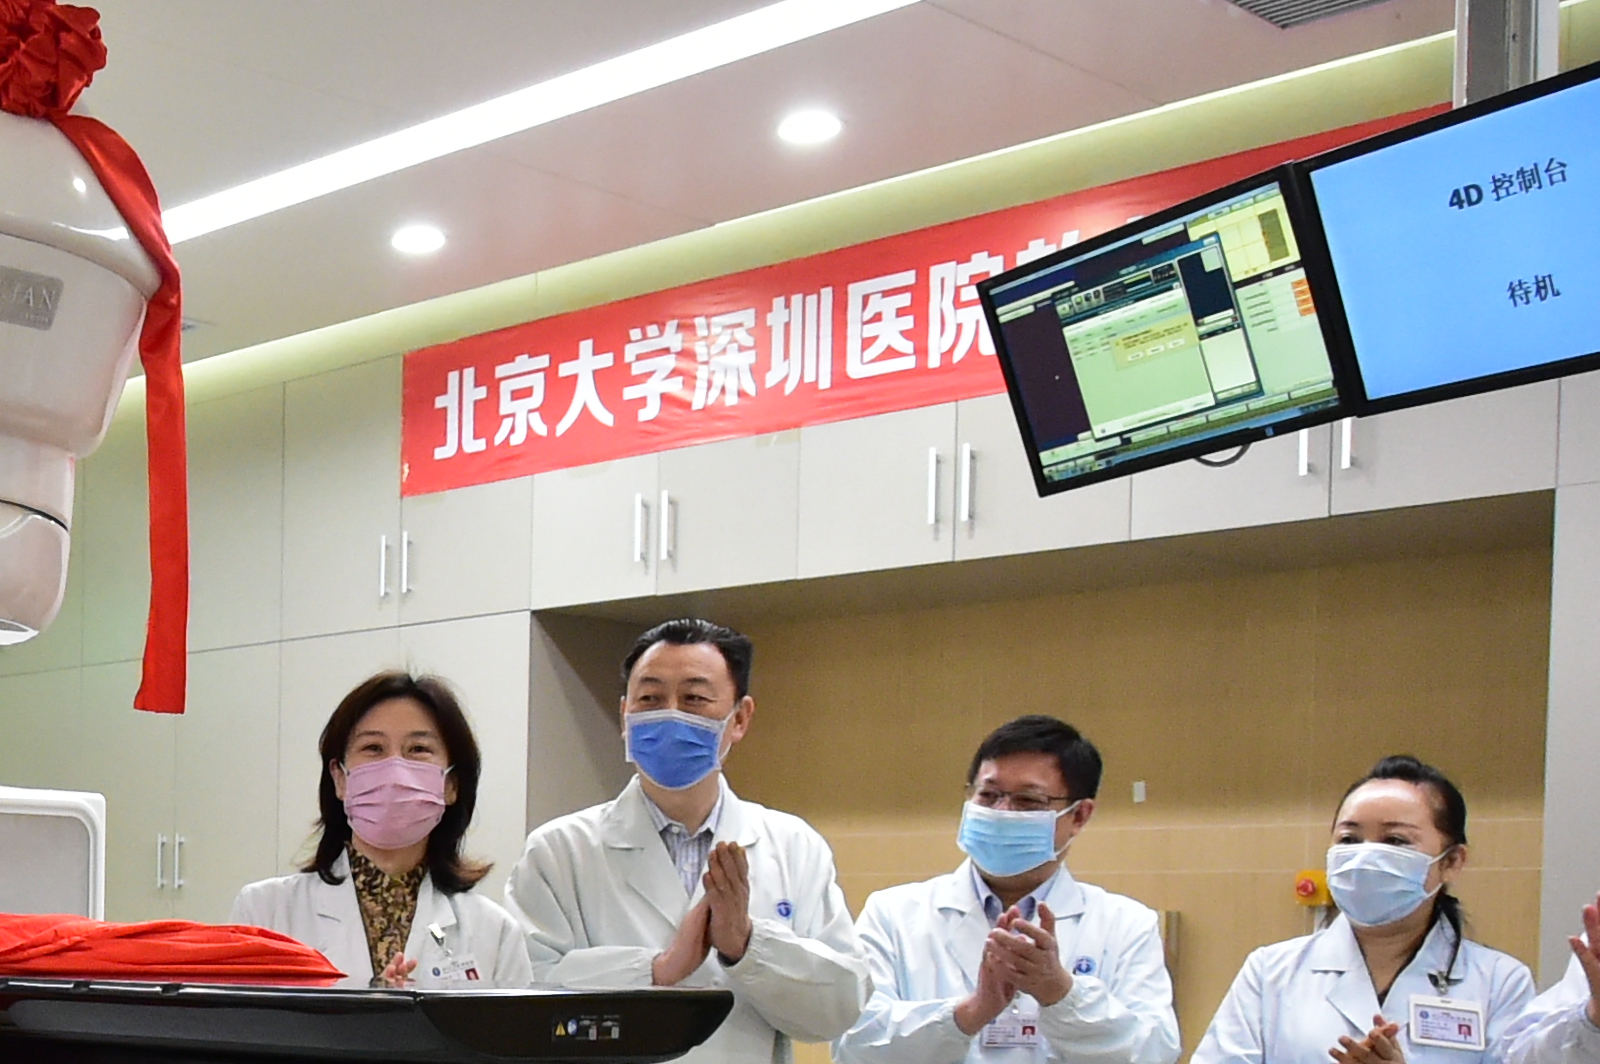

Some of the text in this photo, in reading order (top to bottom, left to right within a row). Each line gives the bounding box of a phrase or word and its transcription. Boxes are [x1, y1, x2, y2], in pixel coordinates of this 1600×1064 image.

[1449, 157, 1568, 210] 4D 控制台
[1507, 273, 1561, 308] 待机
[433, 229, 1080, 461] 北京大学深圳医院
